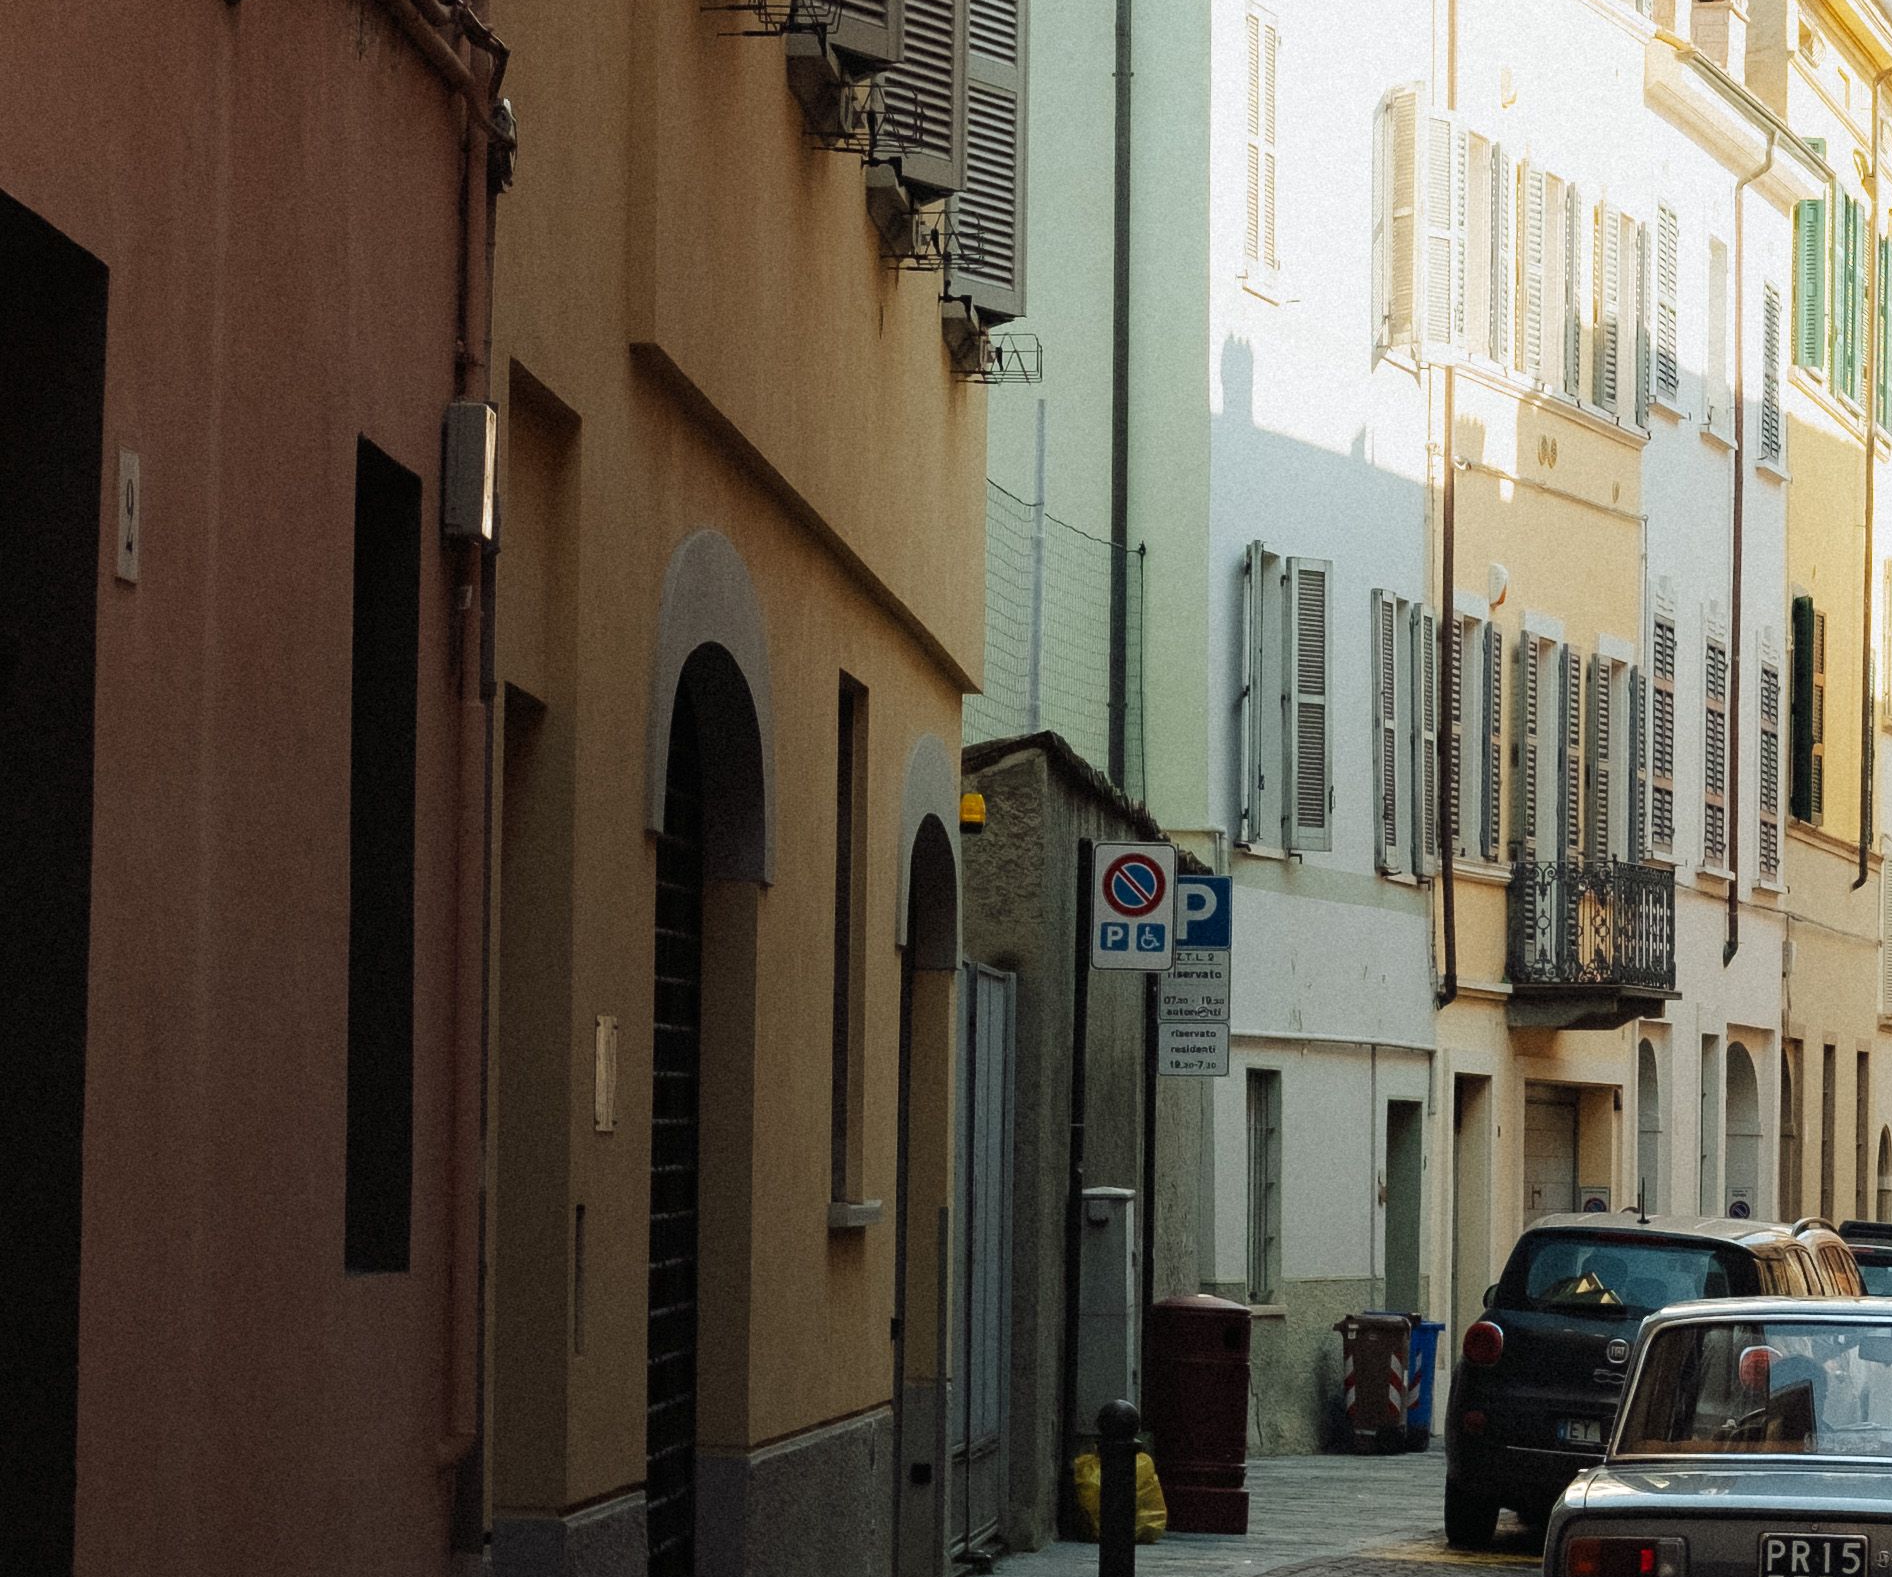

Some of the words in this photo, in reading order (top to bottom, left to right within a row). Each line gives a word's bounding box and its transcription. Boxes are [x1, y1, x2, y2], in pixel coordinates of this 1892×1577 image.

[1177, 883, 1218, 940] P
[1107, 926, 1124, 948] P
[1167, 969, 1222, 980] riservato
[1170, 1029, 1217, 1038] riservato
[1170, 1044, 1216, 1054] residenti
